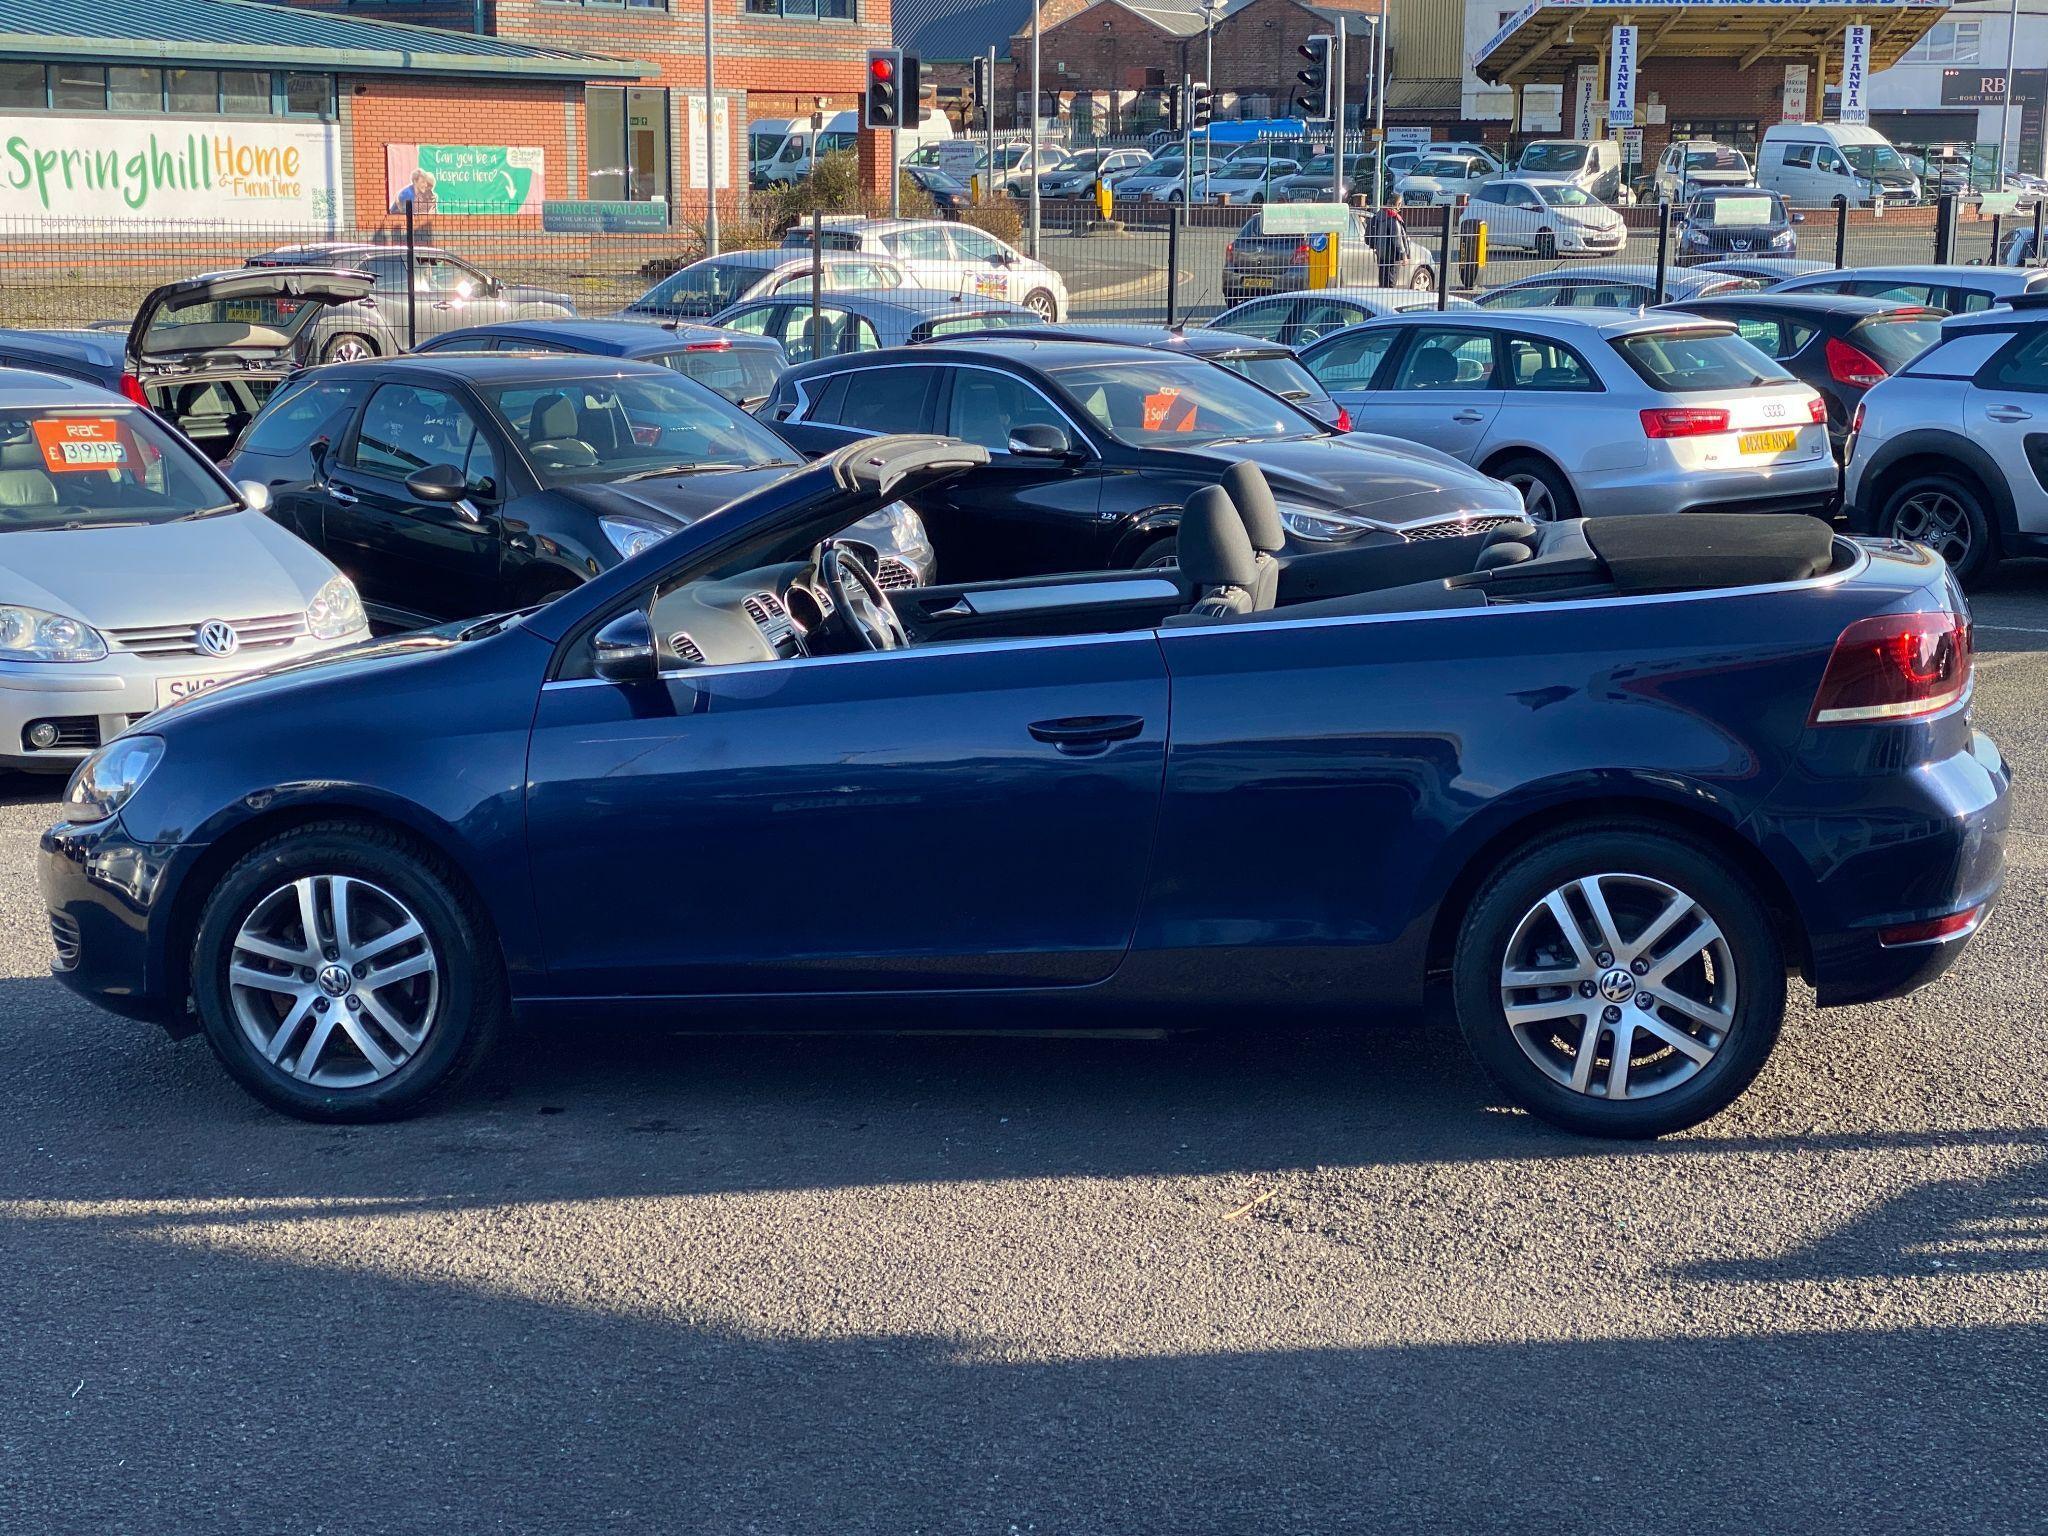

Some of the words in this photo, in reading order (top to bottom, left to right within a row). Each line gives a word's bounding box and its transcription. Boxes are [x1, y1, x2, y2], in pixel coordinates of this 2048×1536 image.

[1617, 28, 1631, 108] BRITANNIA
[1848, 27, 1865, 107] BRITANNIA
[1980, 77, 2006, 93] RB
[1609, 110, 1634, 121] MOTORS
[1841, 109, 1865, 121] MOTORS
[435, 150, 453, 164] Can
[456, 151, 473, 167] you
[476, 150, 488, 164] be
[490, 153, 498, 165] a
[6, 132, 213, 210] Springhill
[214, 134, 300, 178] Home
[435, 168, 470, 186] Hospice
[218, 172, 233, 188] &
[233, 174, 301, 199] Furniture
[544, 203, 598, 215] FINANCE
[600, 203, 665, 216] AVAILABLE
[41, 216, 75, 229] Support
[76, 217, 96, 229] your
[118, 217, 150, 230] Hospice
